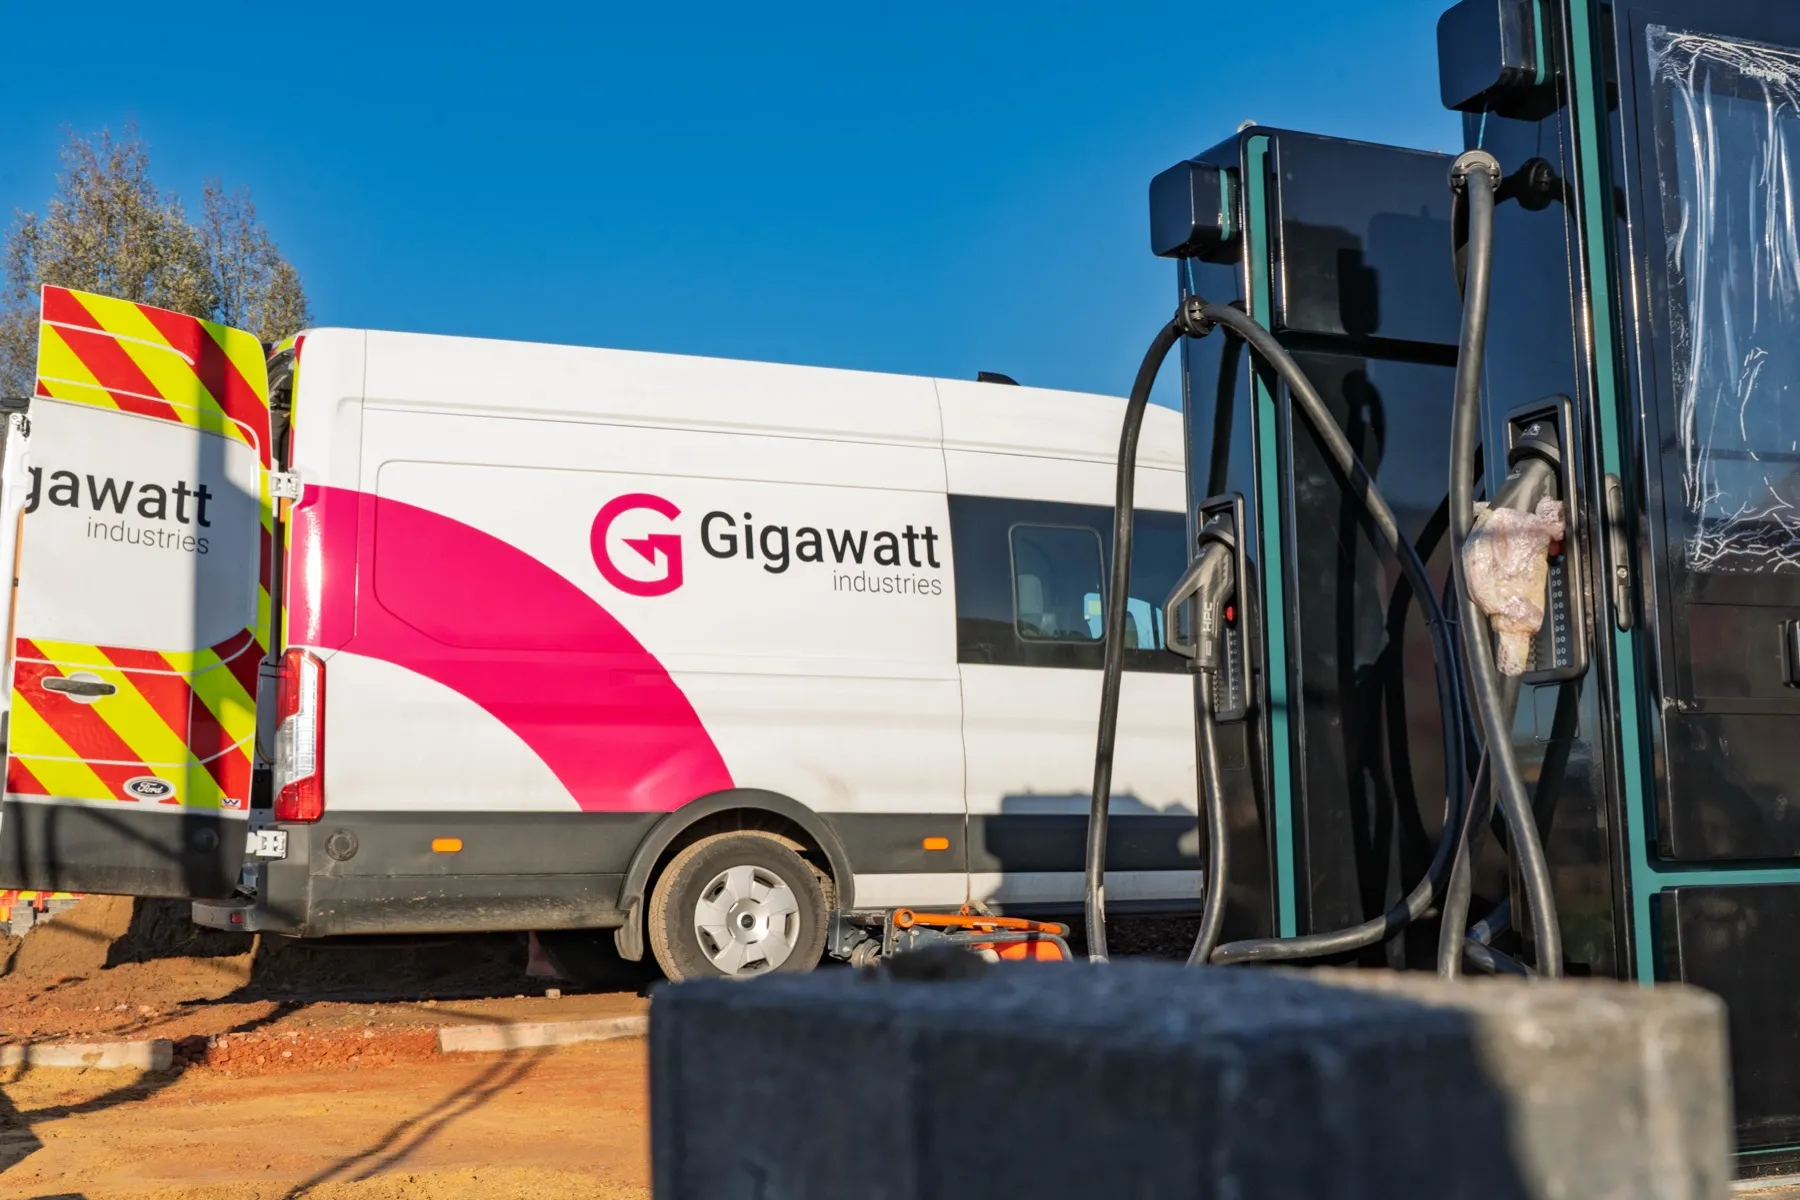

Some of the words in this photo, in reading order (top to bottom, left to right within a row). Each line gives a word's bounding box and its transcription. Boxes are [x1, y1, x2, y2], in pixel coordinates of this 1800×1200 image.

[87, 517, 210, 555] industries
[700, 510, 941, 574] Gigawatt
[833, 570, 942, 596] industries
[1203, 601, 1213, 632] HPC
[137, 782, 163, 794] Ford
